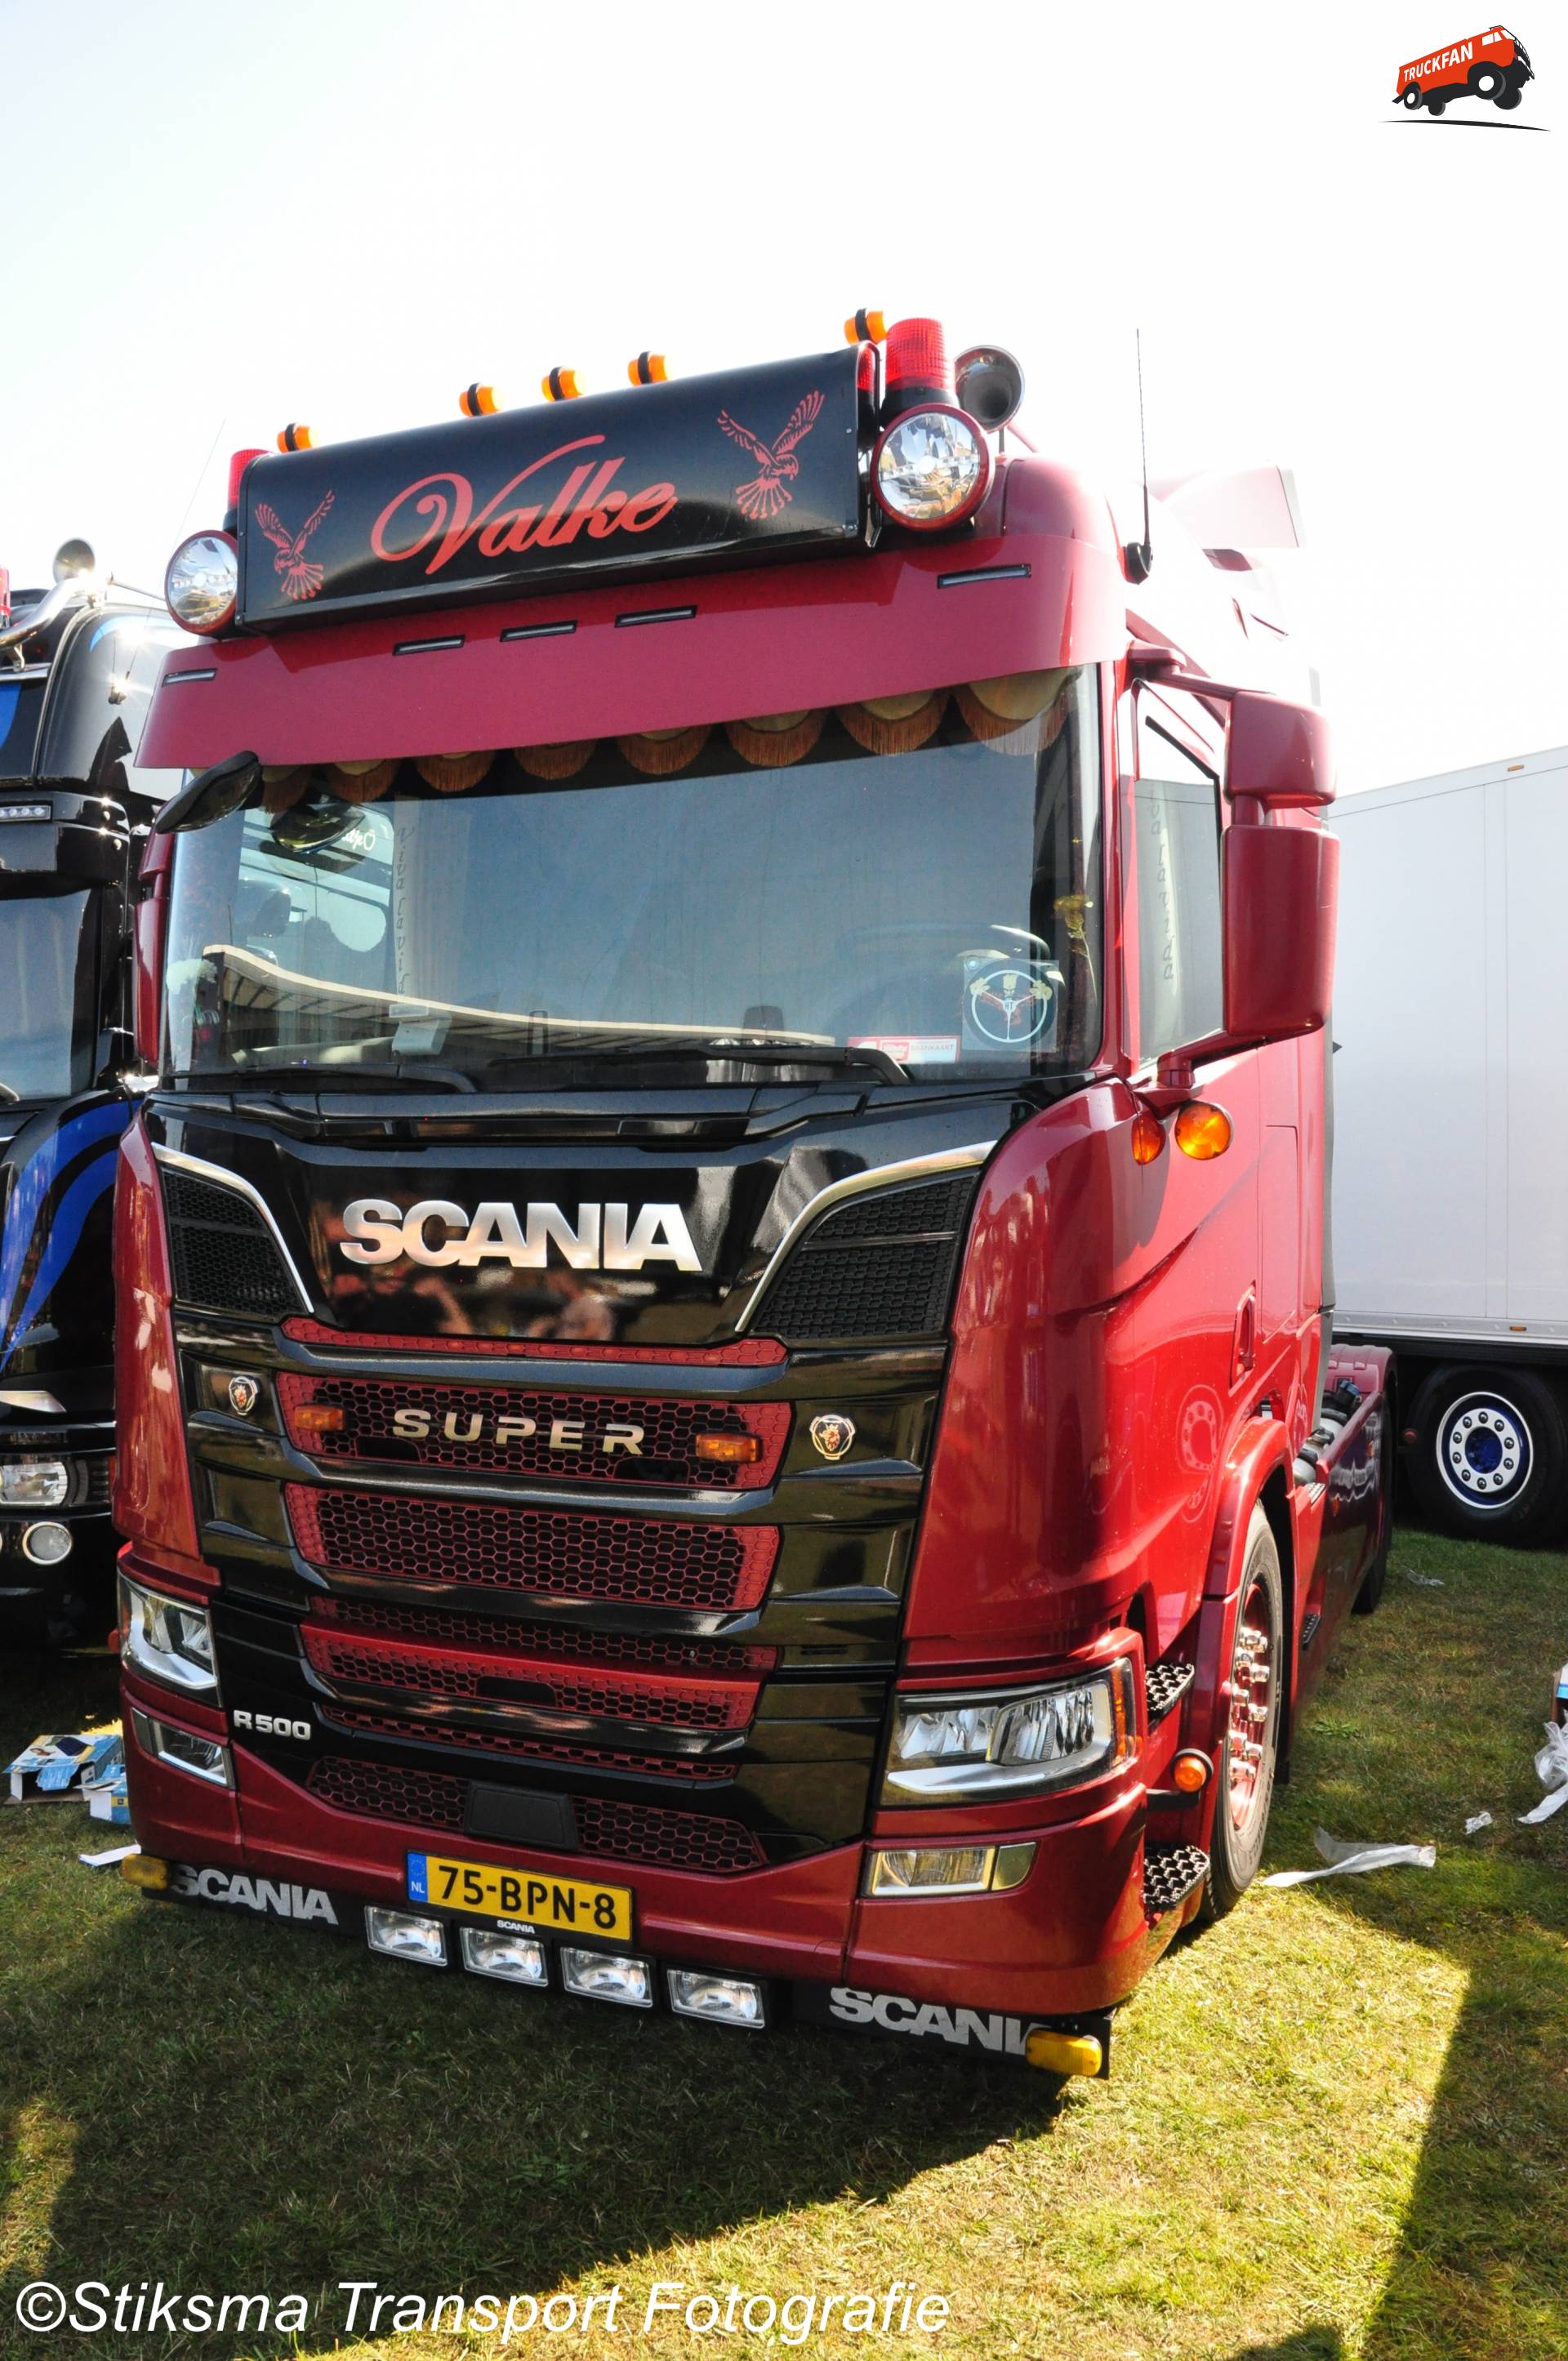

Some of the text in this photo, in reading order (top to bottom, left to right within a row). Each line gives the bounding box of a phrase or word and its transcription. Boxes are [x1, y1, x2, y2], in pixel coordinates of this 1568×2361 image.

[371, 434, 679, 575] Valke
[340, 1199, 702, 1271] SCANIA
[393, 1409, 644, 1454] SUPER
[171, 1864, 339, 1925] SCANIA
[412, 1881, 425, 1894] NL
[439, 1865, 617, 1929] 75-BPN-8
[497, 1919, 536, 1935] SCANIA
[829, 1987, 1053, 2056] SCANI
